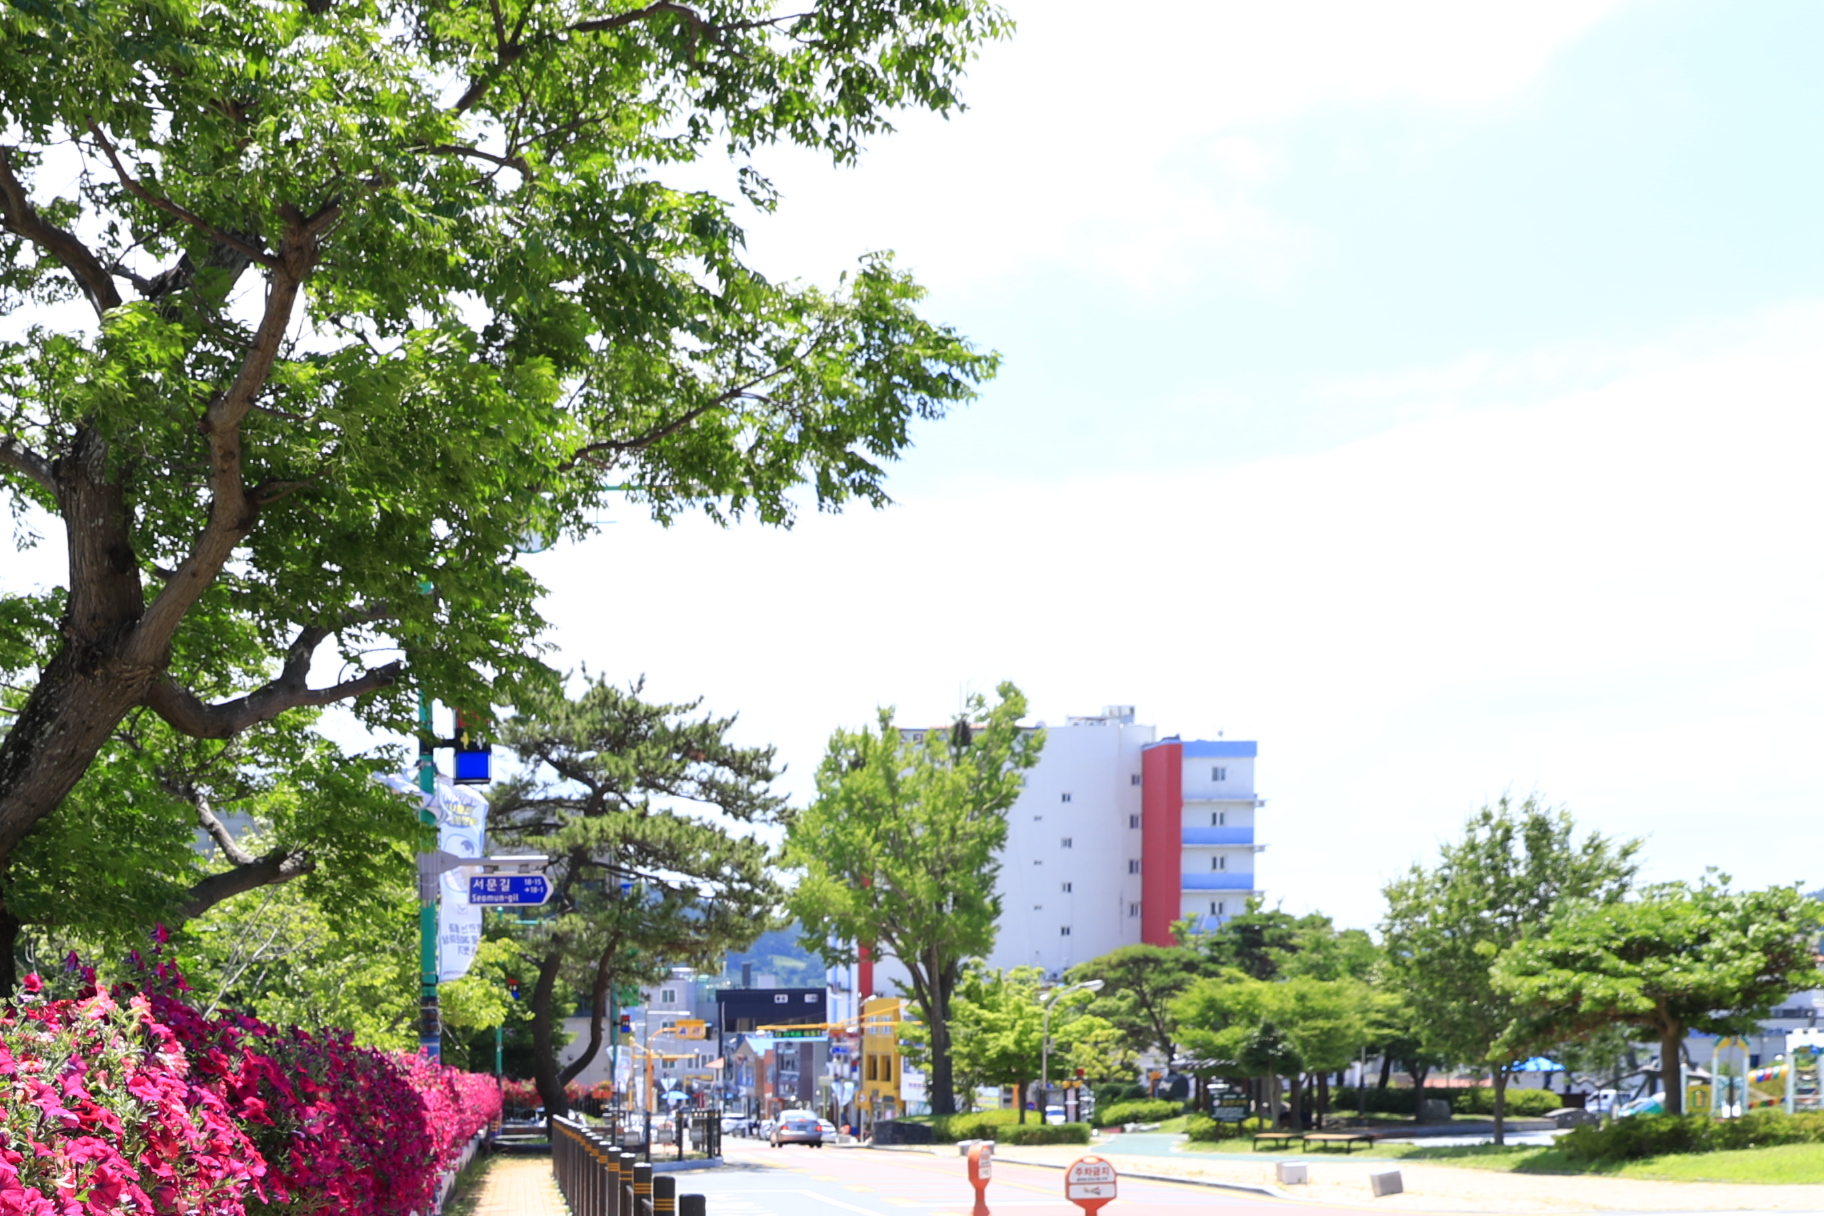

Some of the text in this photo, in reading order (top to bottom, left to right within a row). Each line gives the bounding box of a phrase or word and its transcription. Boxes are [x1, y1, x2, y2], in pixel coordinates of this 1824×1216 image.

[473, 878, 511, 892] 서문길
[472, 893, 519, 903] Seomun-gil
[1075, 1166, 1110, 1177] 주차금지
